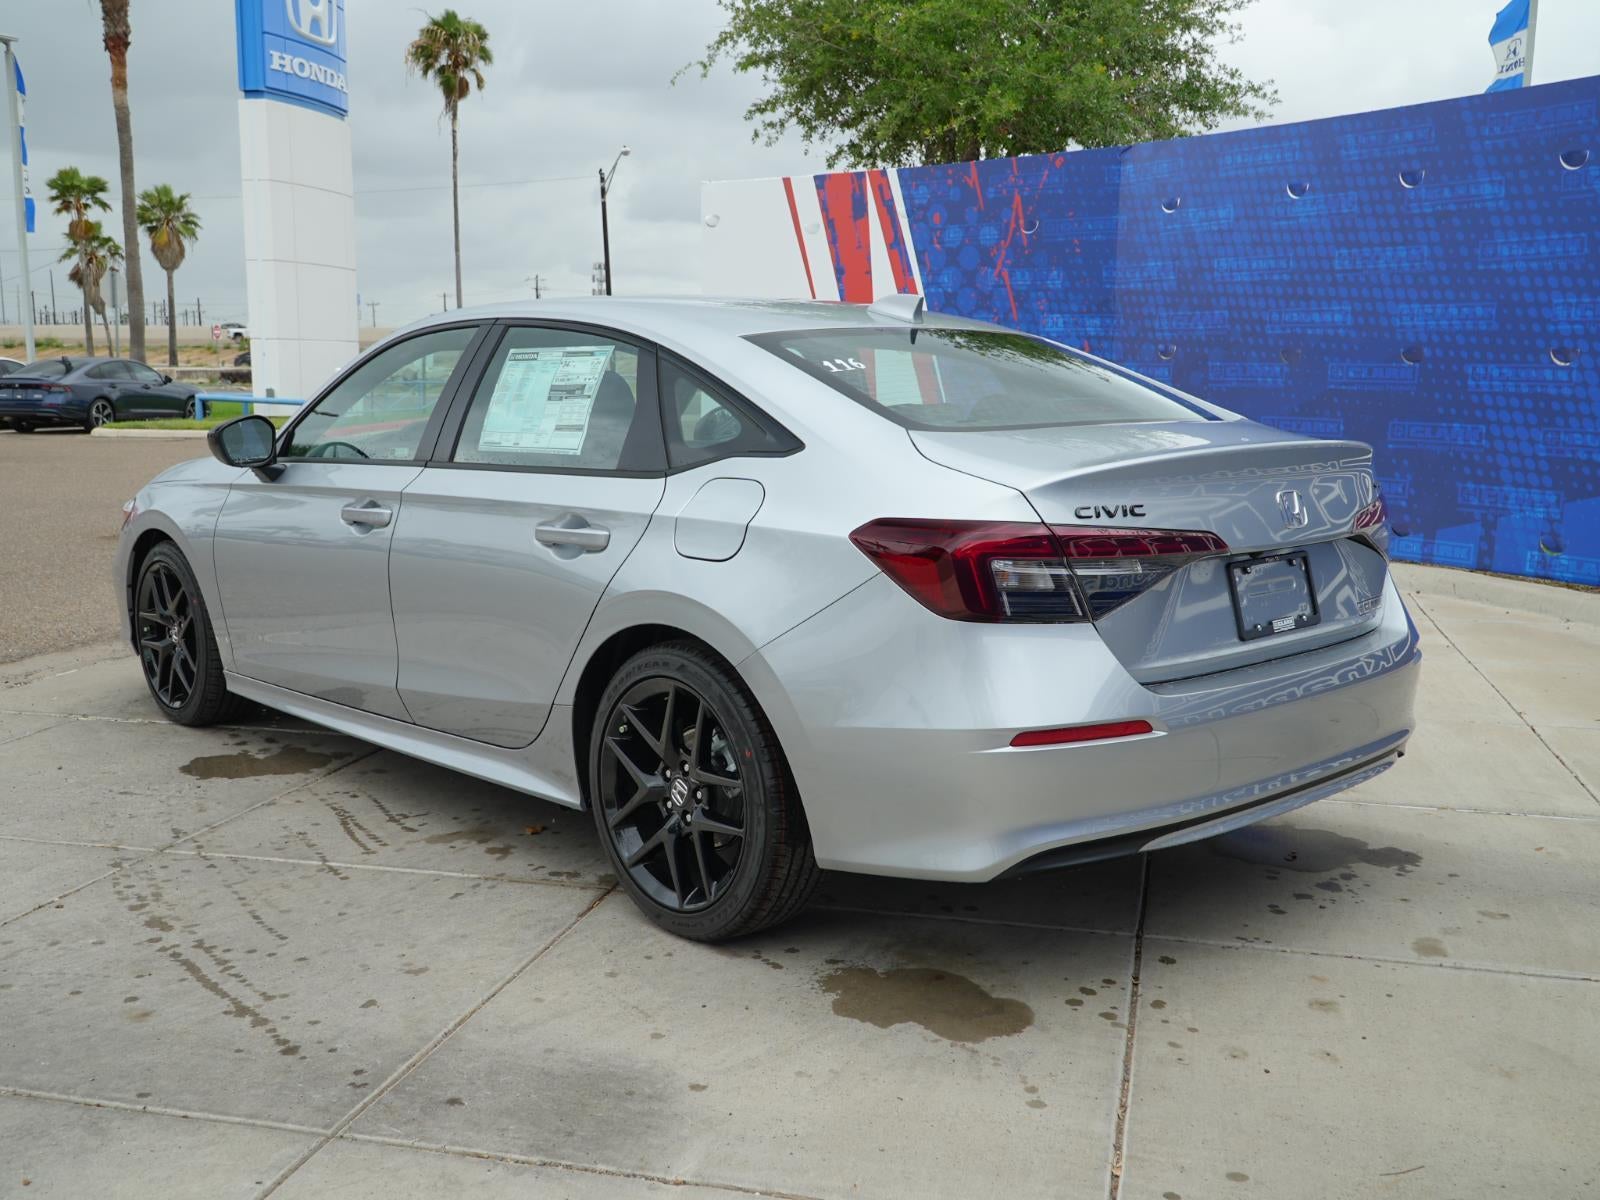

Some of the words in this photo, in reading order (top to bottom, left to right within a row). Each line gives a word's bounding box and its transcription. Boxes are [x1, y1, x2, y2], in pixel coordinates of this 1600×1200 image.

[269, 50, 348, 94] HONDA
[823, 357, 866, 373] 116
[1074, 504, 1146, 519] CIVIC
